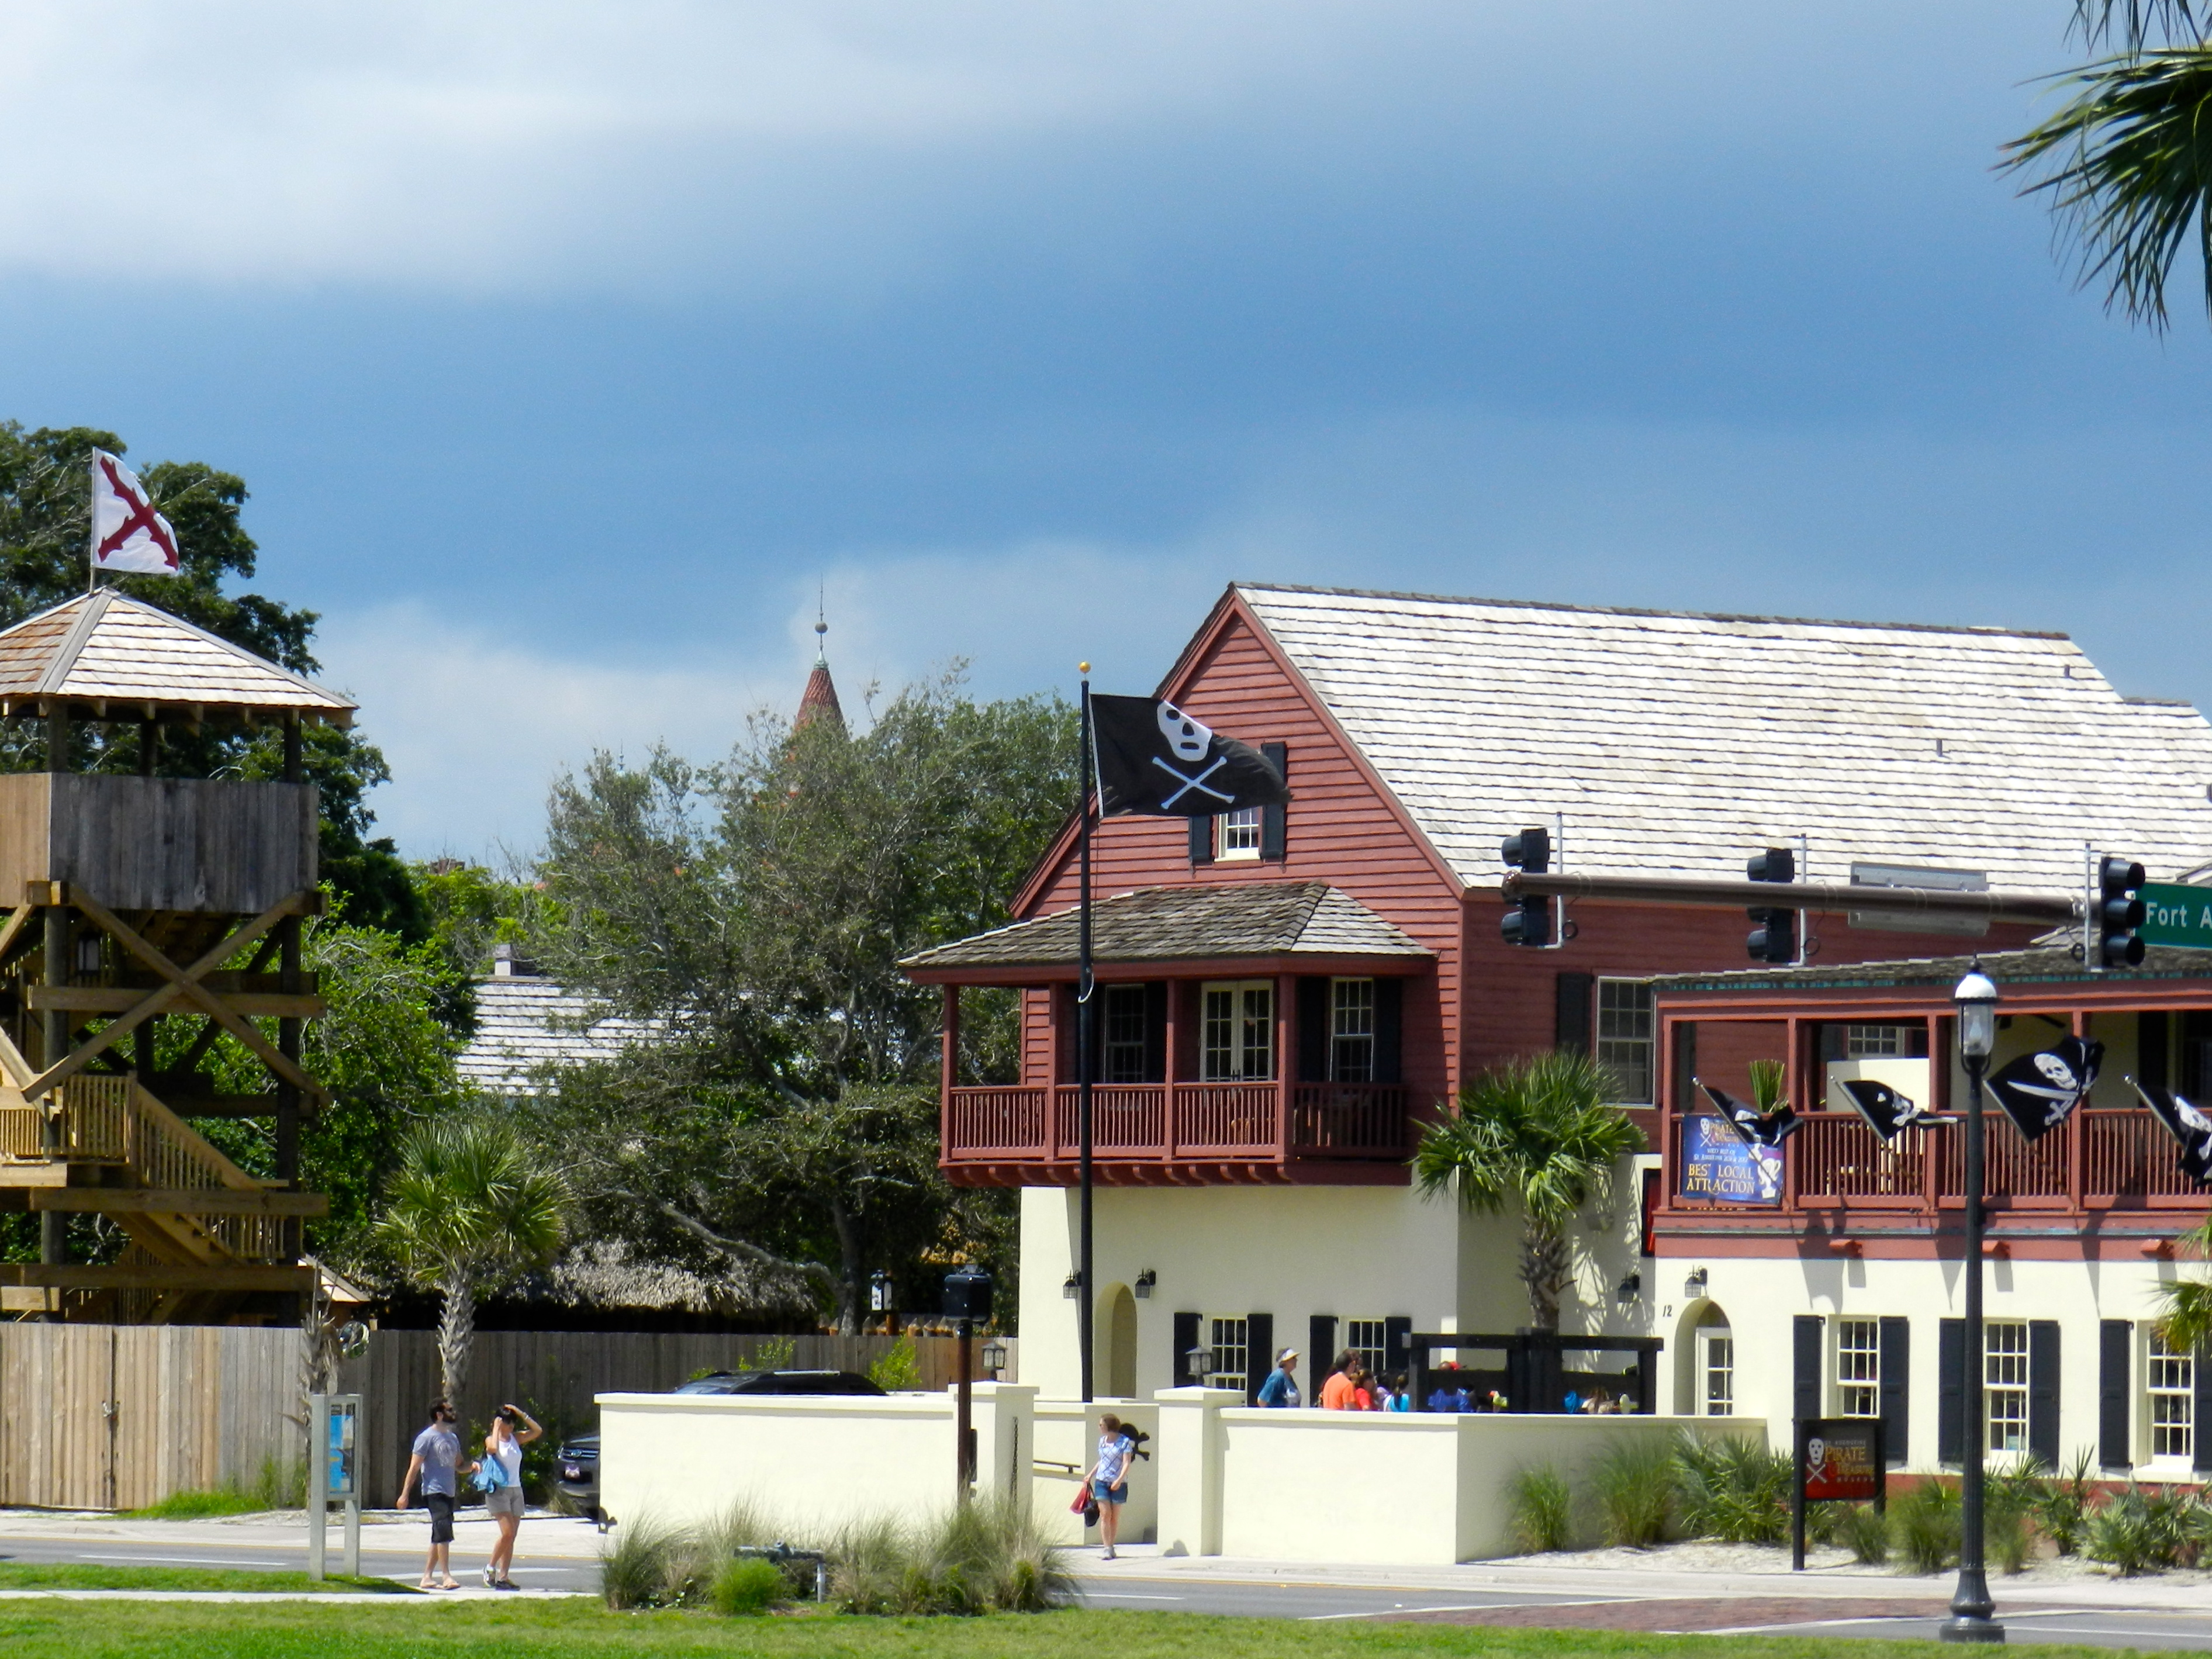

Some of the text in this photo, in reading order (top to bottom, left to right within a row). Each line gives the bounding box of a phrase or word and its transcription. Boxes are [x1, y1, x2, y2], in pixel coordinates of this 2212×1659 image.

[2146, 901, 2187, 928] Fort
[1688, 1163, 1754, 1180] BES LOCAL
[1663, 1304, 1672, 1317] 12
[1825, 1446, 1866, 1462] PIRATE
